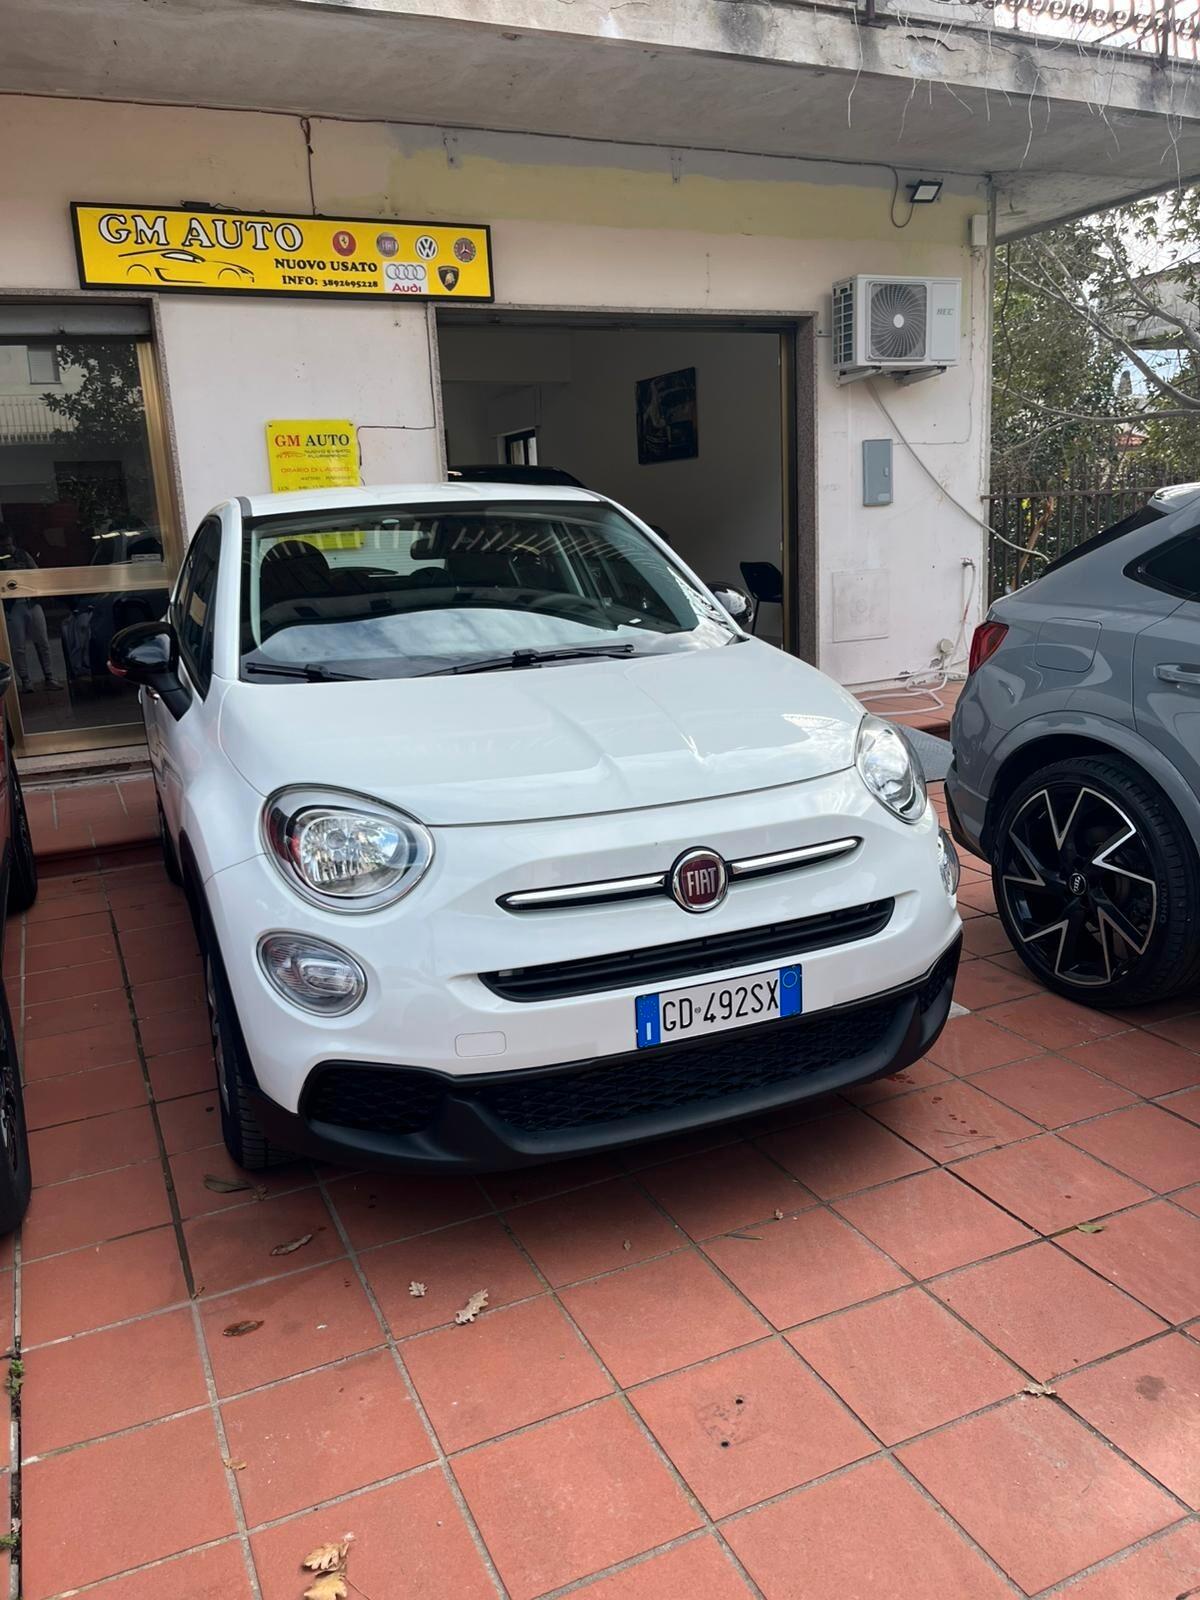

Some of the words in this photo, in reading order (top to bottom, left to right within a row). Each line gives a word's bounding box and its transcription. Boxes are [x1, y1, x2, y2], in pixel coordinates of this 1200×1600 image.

[98, 213, 169, 246] GM
[182, 217, 303, 251] AUTO
[274, 258, 326, 271] NUOVO
[330, 260, 378, 273] USATO
[282, 275, 318, 286] INFO:
[392, 283, 421, 292] Audi
[274, 434, 301, 447] GM
[305, 434, 350, 447] AUTO
[686, 867, 717, 897] FIAT
